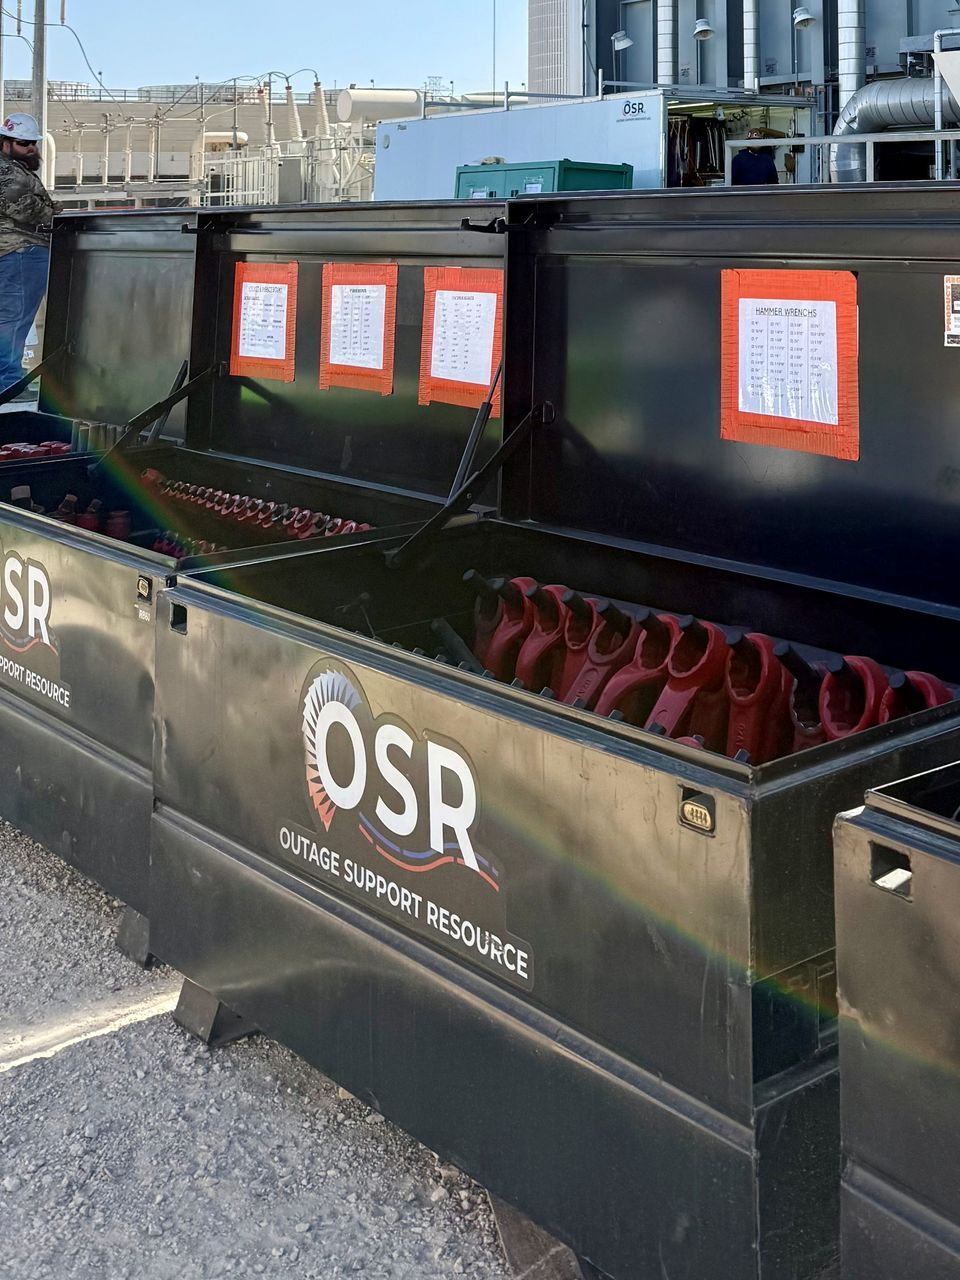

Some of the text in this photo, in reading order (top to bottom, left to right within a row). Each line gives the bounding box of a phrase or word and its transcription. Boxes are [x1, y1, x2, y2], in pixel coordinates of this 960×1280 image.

[623, 102, 645, 115] OSR
[755, 307, 818, 318] HAMMER WRENCHS
[0, 557, 51, 646] SR
[25, 669, 71, 708] RESOURCE
[314, 700, 480, 872] OSR
[279, 826, 529, 979] OUTAGE SUPPORT RESOURCE
